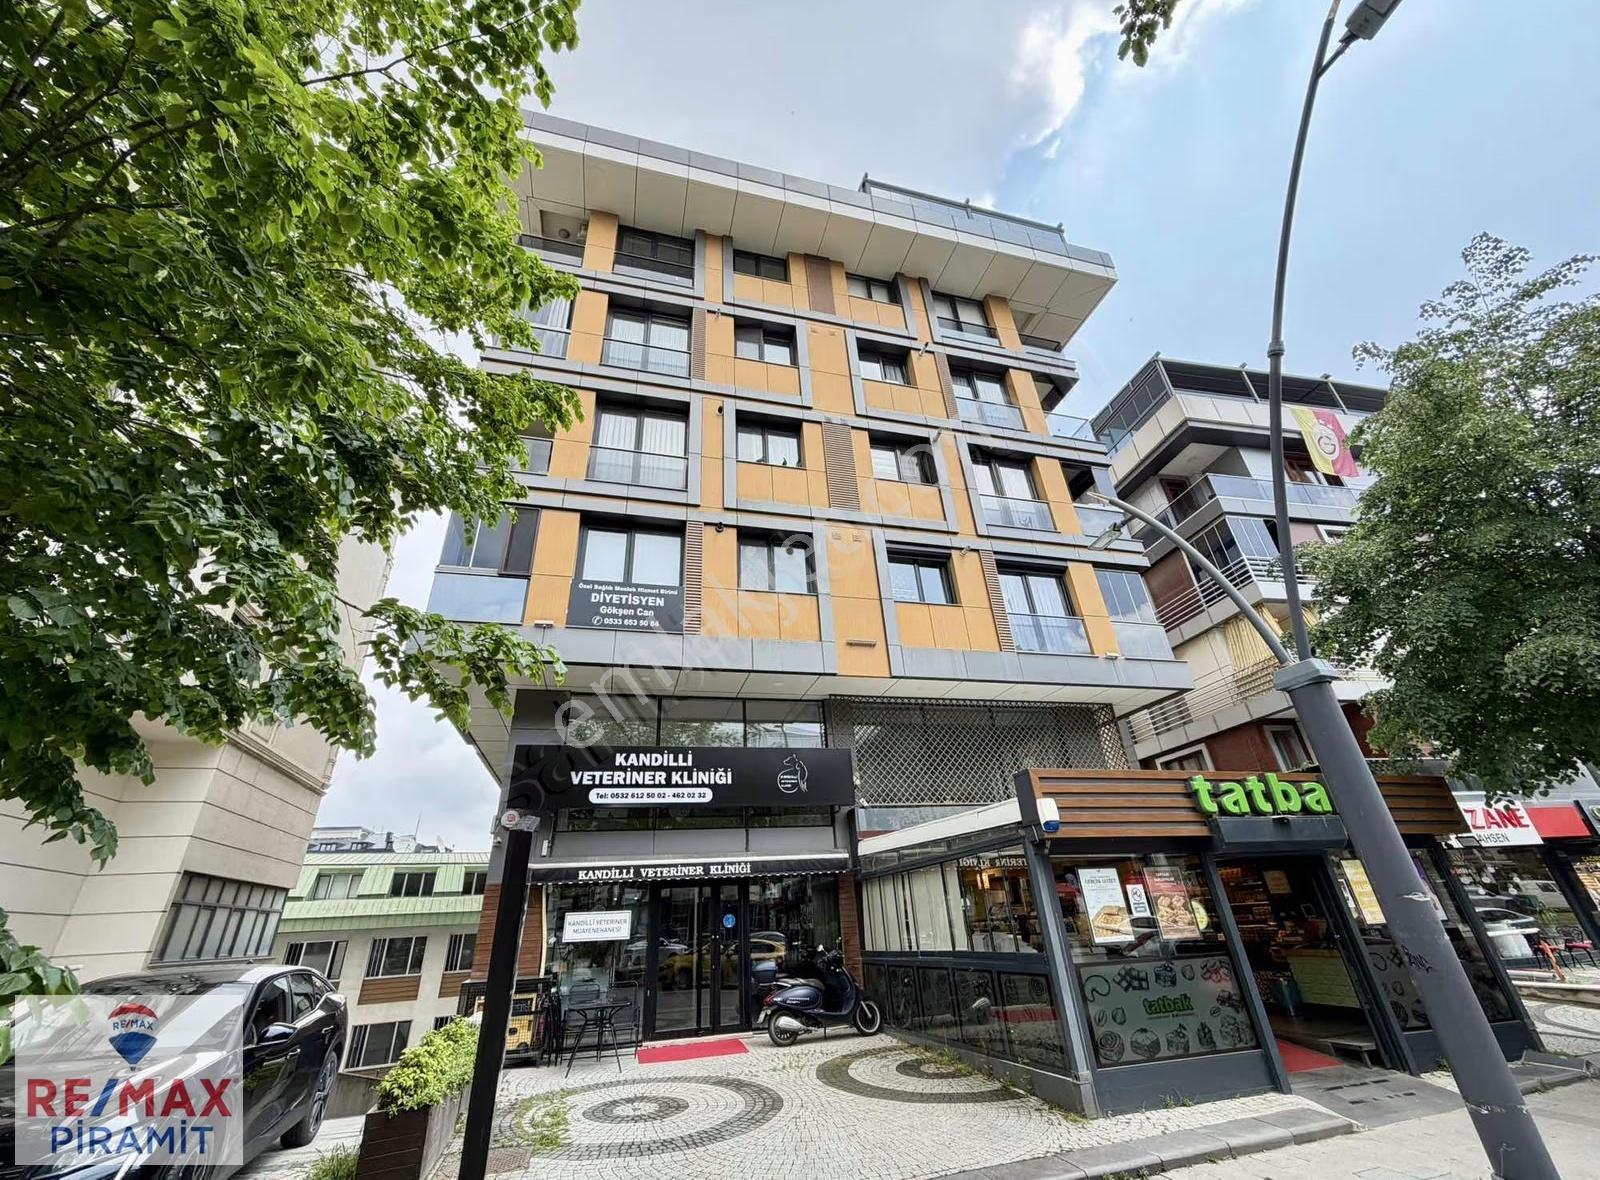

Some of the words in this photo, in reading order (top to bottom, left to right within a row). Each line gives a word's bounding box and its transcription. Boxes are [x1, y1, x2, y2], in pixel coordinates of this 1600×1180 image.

[591, 592, 665, 607] DİYETİSYEN
[600, 606, 634, 616] Gökşen
[636, 607, 655, 618] Can
[615, 750, 693, 767] KANDİLLİ
[570, 767, 667, 785] VETERİNER
[671, 767, 733, 785] KLİNİĞİ
[1189, 772, 1333, 816] tatba
[1463, 807, 1530, 830] ZANE
[578, 866, 634, 880] KANDİLLİ
[640, 864, 704, 878] VETERİNER
[709, 861, 751, 875] KLİNİĞİ
